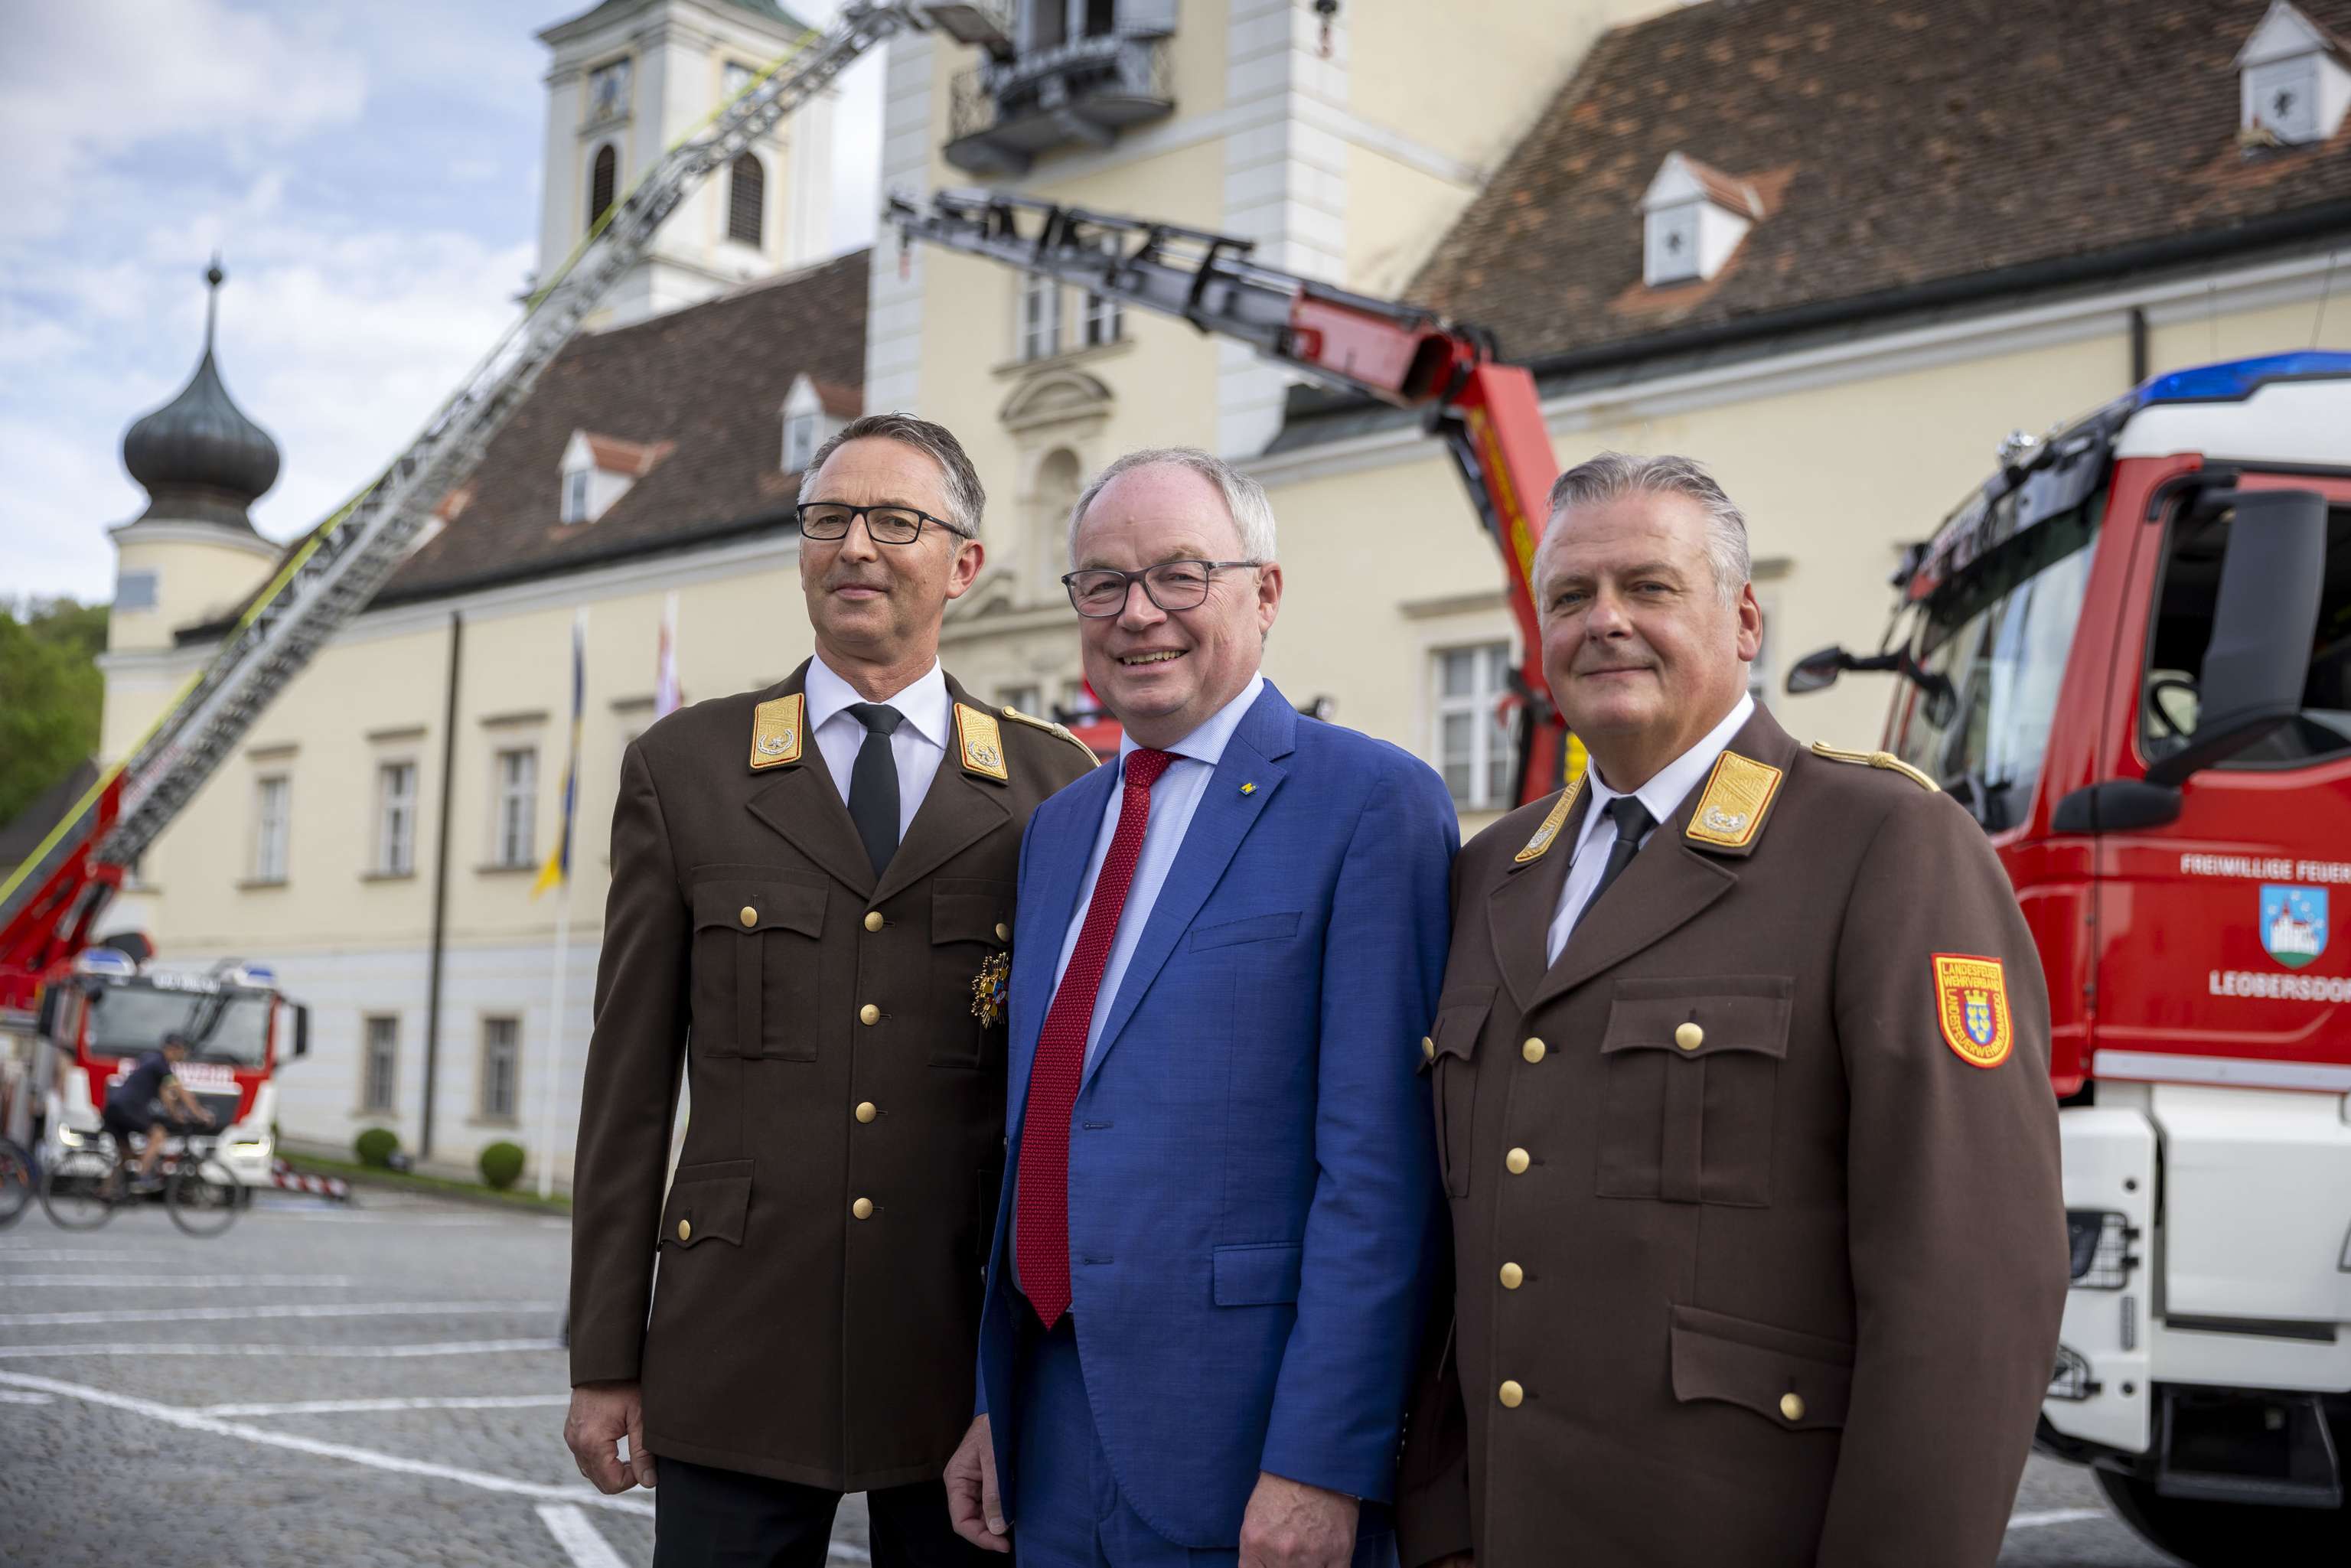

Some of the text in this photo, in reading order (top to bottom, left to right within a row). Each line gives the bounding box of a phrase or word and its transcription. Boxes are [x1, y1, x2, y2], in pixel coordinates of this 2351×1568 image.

[2181, 854, 2294, 880] FREIWILLIGE
[1942, 963, 1997, 979] LANDESFEUER
[1943, 976, 2000, 992] WEHRVERBAND
